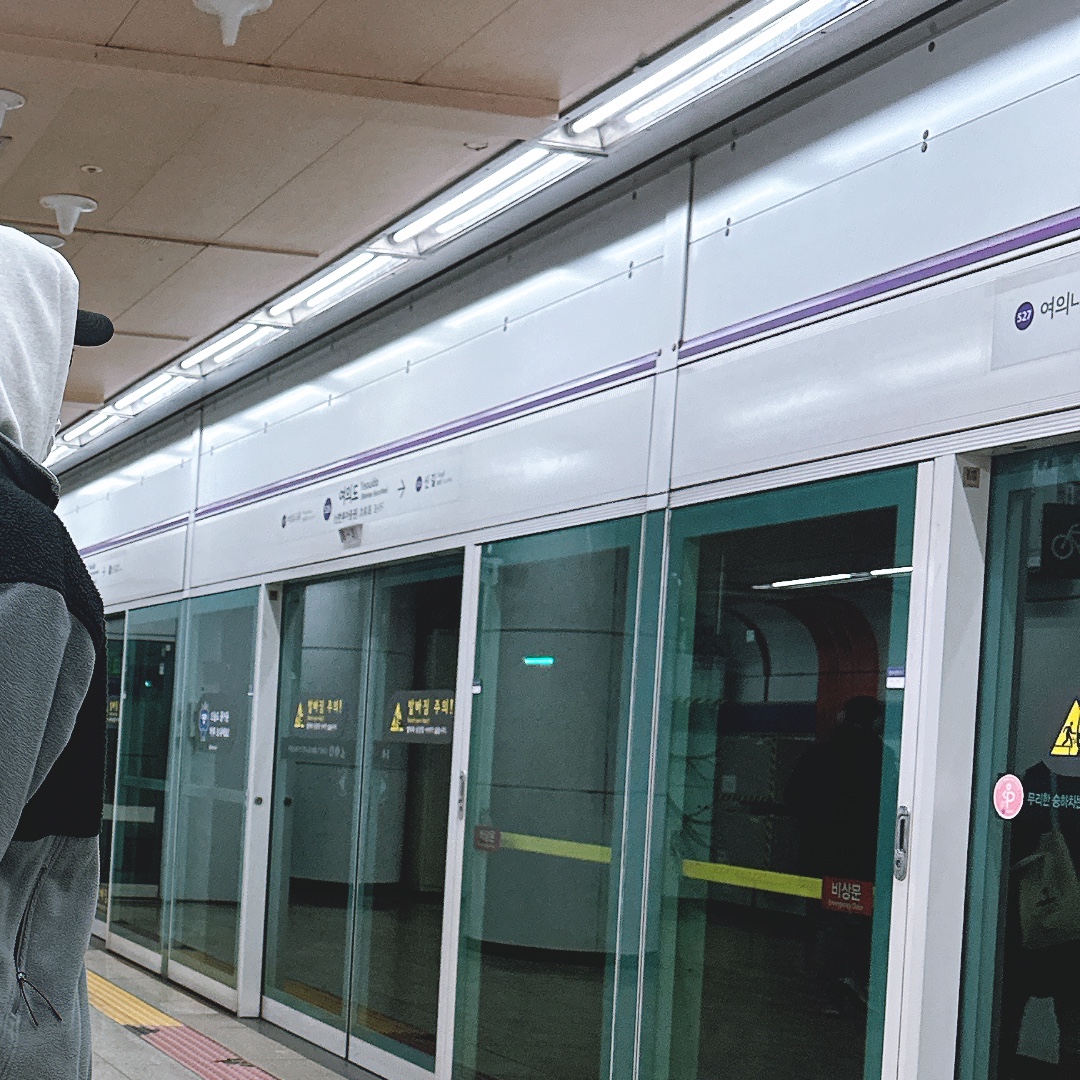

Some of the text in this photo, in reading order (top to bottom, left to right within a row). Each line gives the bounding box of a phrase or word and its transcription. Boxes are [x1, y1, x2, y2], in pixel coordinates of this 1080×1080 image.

[1017, 309, 1032, 323] 527
[1027, 791, 1050, 807] 무리한
[831, 881, 862, 901] 비상문
